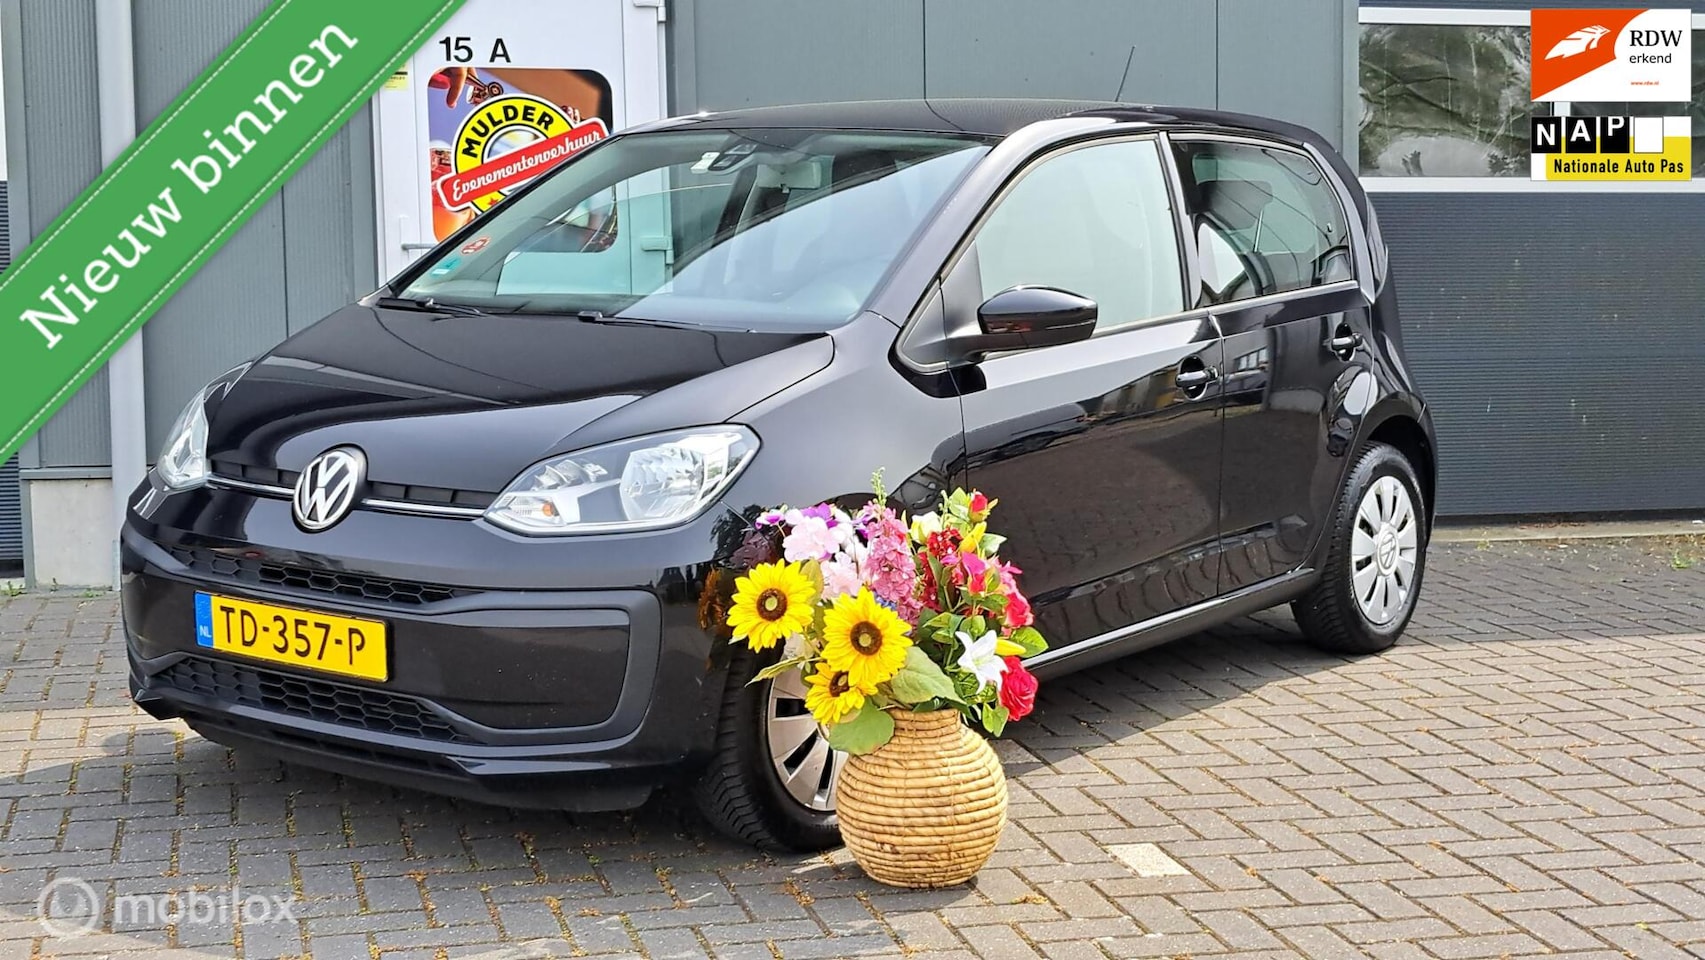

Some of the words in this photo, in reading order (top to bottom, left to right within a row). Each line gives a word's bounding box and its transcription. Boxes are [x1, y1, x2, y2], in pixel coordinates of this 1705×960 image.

[439, 36, 474, 63] 15
[488, 38, 512, 63] A
[461, 104, 554, 159] MULDER
[452, 129, 601, 202] Evenementenverhuur
[199, 624, 212, 638] NL
[219, 605, 366, 666] TD-357-P
